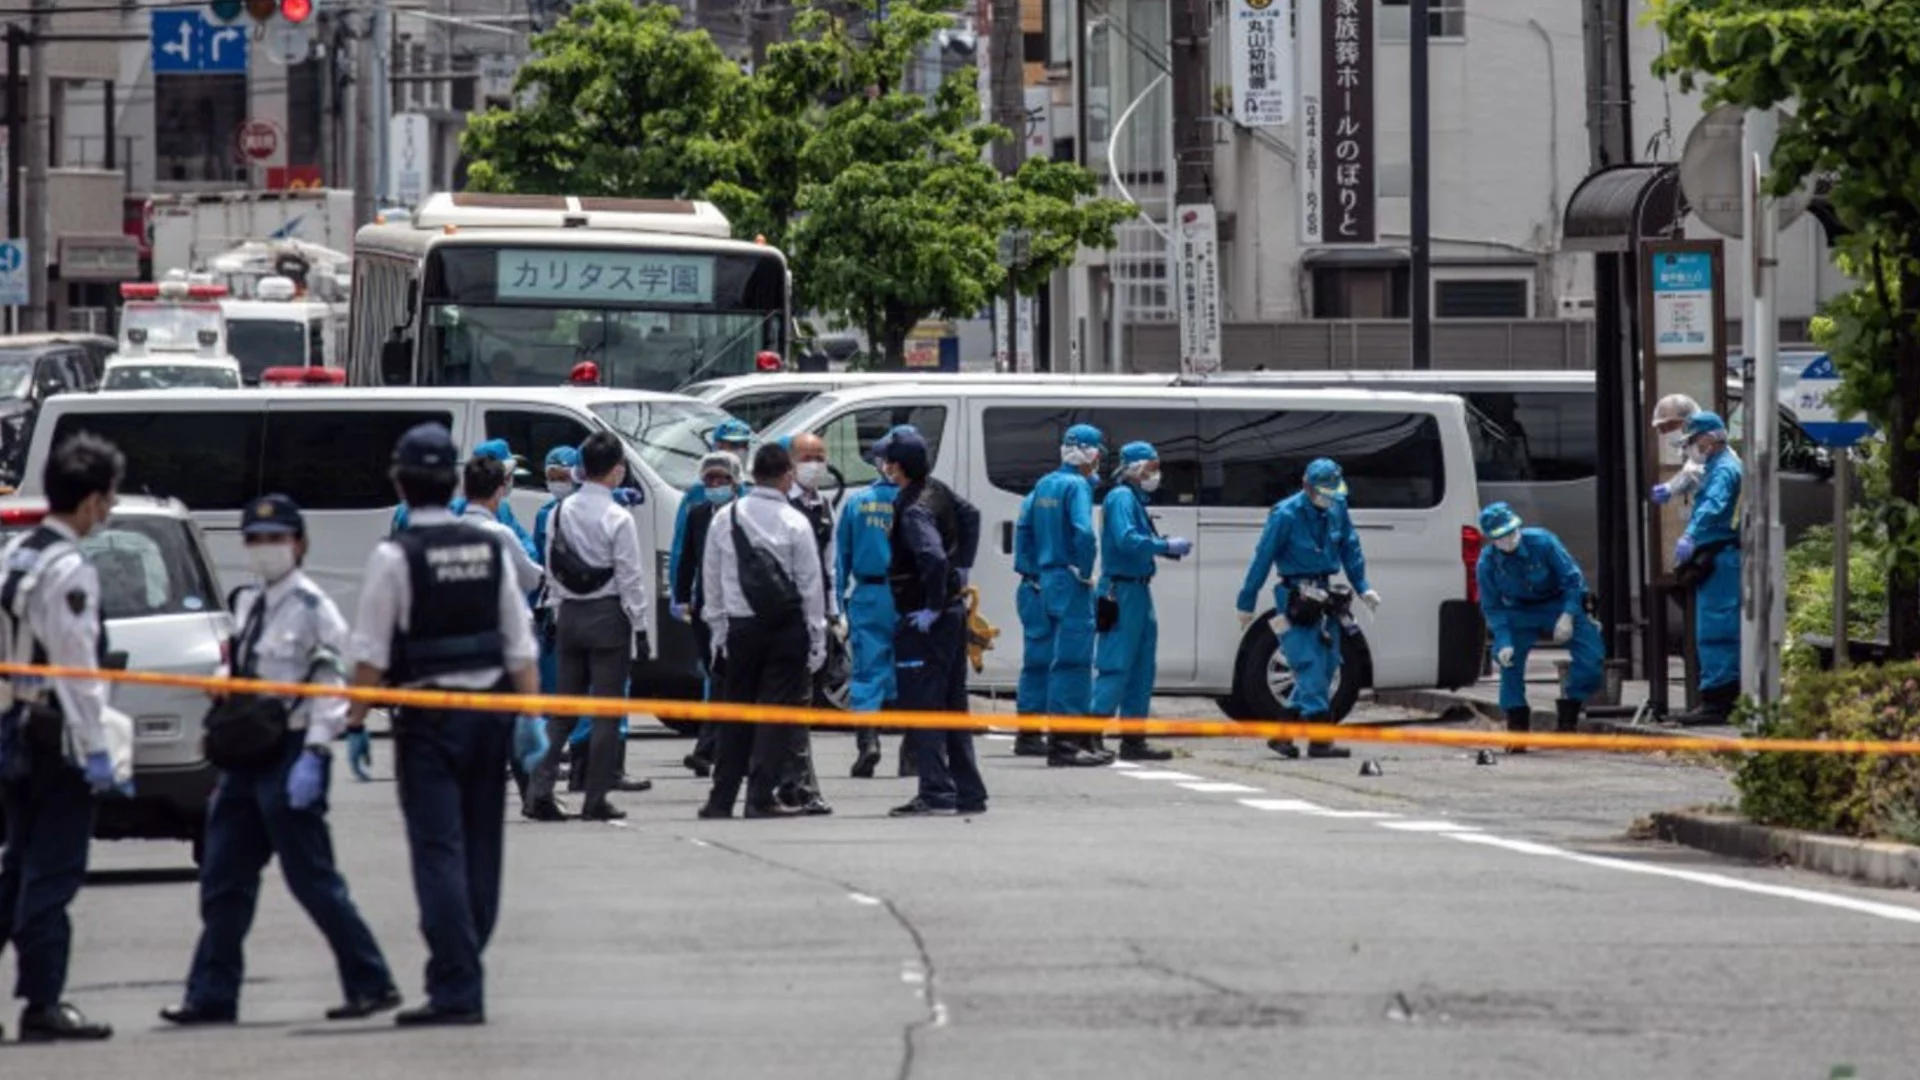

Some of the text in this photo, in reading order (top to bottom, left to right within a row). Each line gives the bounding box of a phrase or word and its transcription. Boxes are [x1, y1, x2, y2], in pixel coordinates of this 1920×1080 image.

[512, 259, 699, 295] カリタス学園
